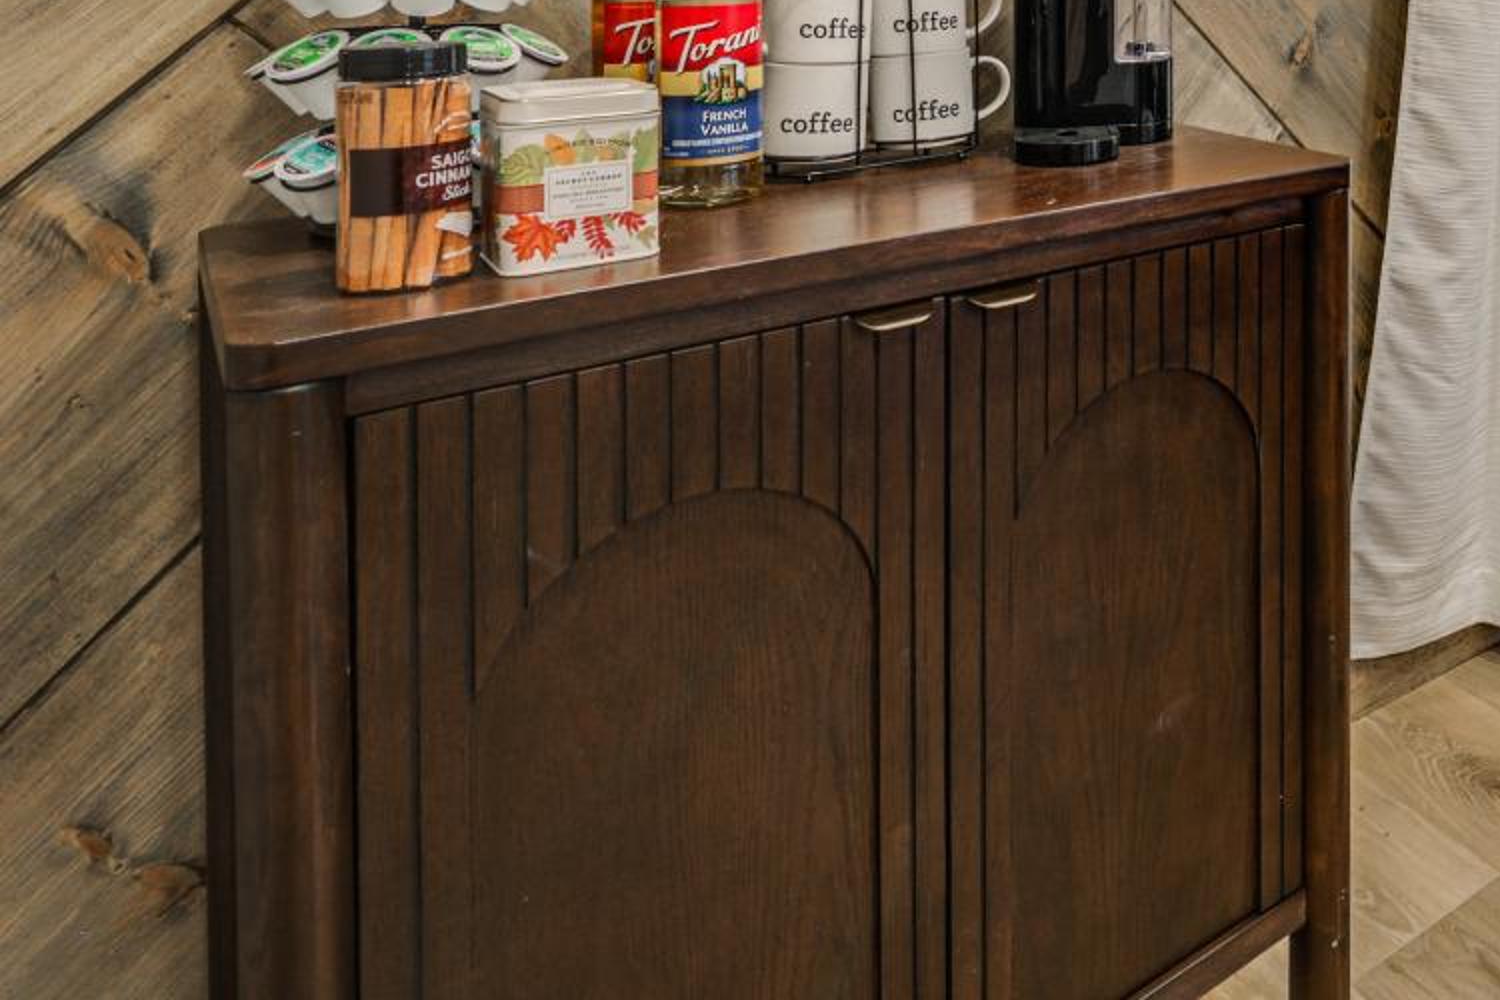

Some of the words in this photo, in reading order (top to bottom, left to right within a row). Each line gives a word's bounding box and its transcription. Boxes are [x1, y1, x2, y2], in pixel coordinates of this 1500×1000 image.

[799, 17, 865, 39] coffee
[893, 11, 959, 33] coffee
[669, 14, 762, 74] Torani
[703, 107, 747, 124] FRENCH
[893, 99, 960, 123] coffee
[701, 121, 750, 137] VANILLA
[780, 111, 853, 134] coffee
